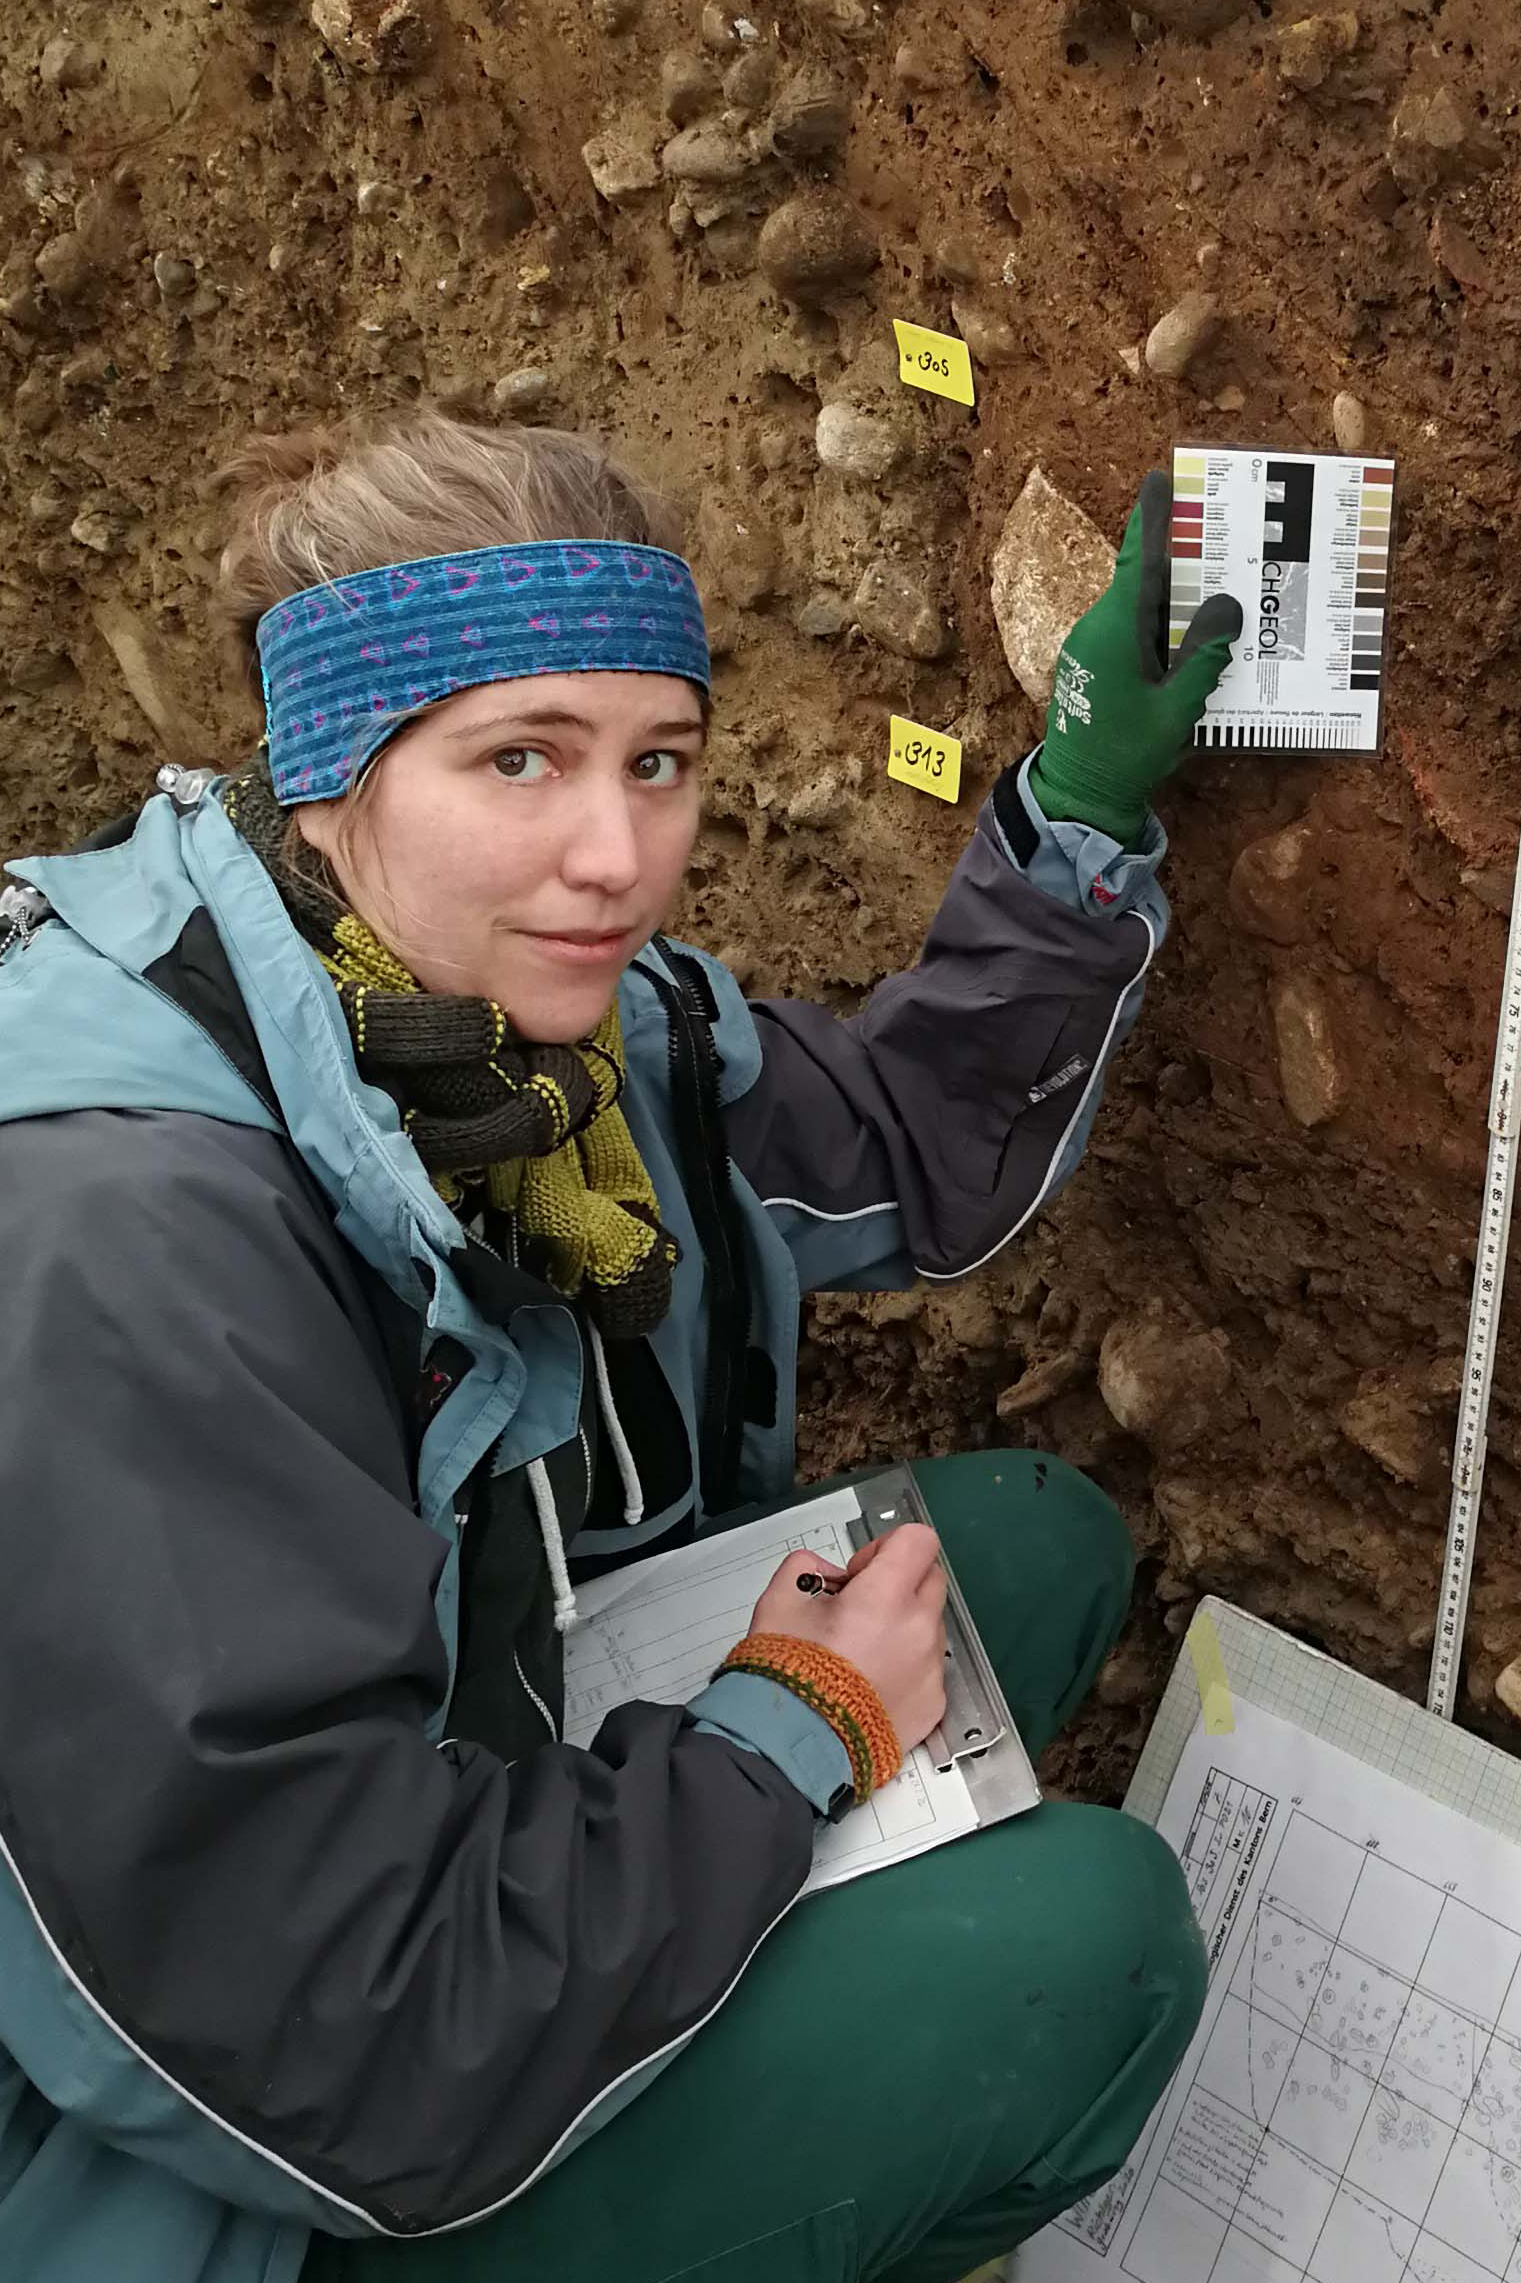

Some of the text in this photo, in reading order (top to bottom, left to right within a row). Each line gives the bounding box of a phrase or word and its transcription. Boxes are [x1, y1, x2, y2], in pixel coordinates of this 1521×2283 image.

[1247, 557, 1258, 565] 5
[1258, 561, 1281, 660] CHGEOL
[1243, 646, 1254, 661] 10
[1509, 1003, 1520, 1018] 75
[1507, 1043, 1515, 1053] 77
[1492, 1188, 1502, 1202] 85
[1482, 1278, 1493, 1292] 90
[1472, 1367, 1482, 1381] 95
[1454, 1537, 1465, 1553] 105
[1443, 1621, 1454, 1636] 110
[1223, 1888, 1241, 1920] Dienst
[1237, 1869, 1248, 1887] des
[1244, 1825, 1263, 1866] Kantons
[1259, 1799, 1273, 1824] Bern
